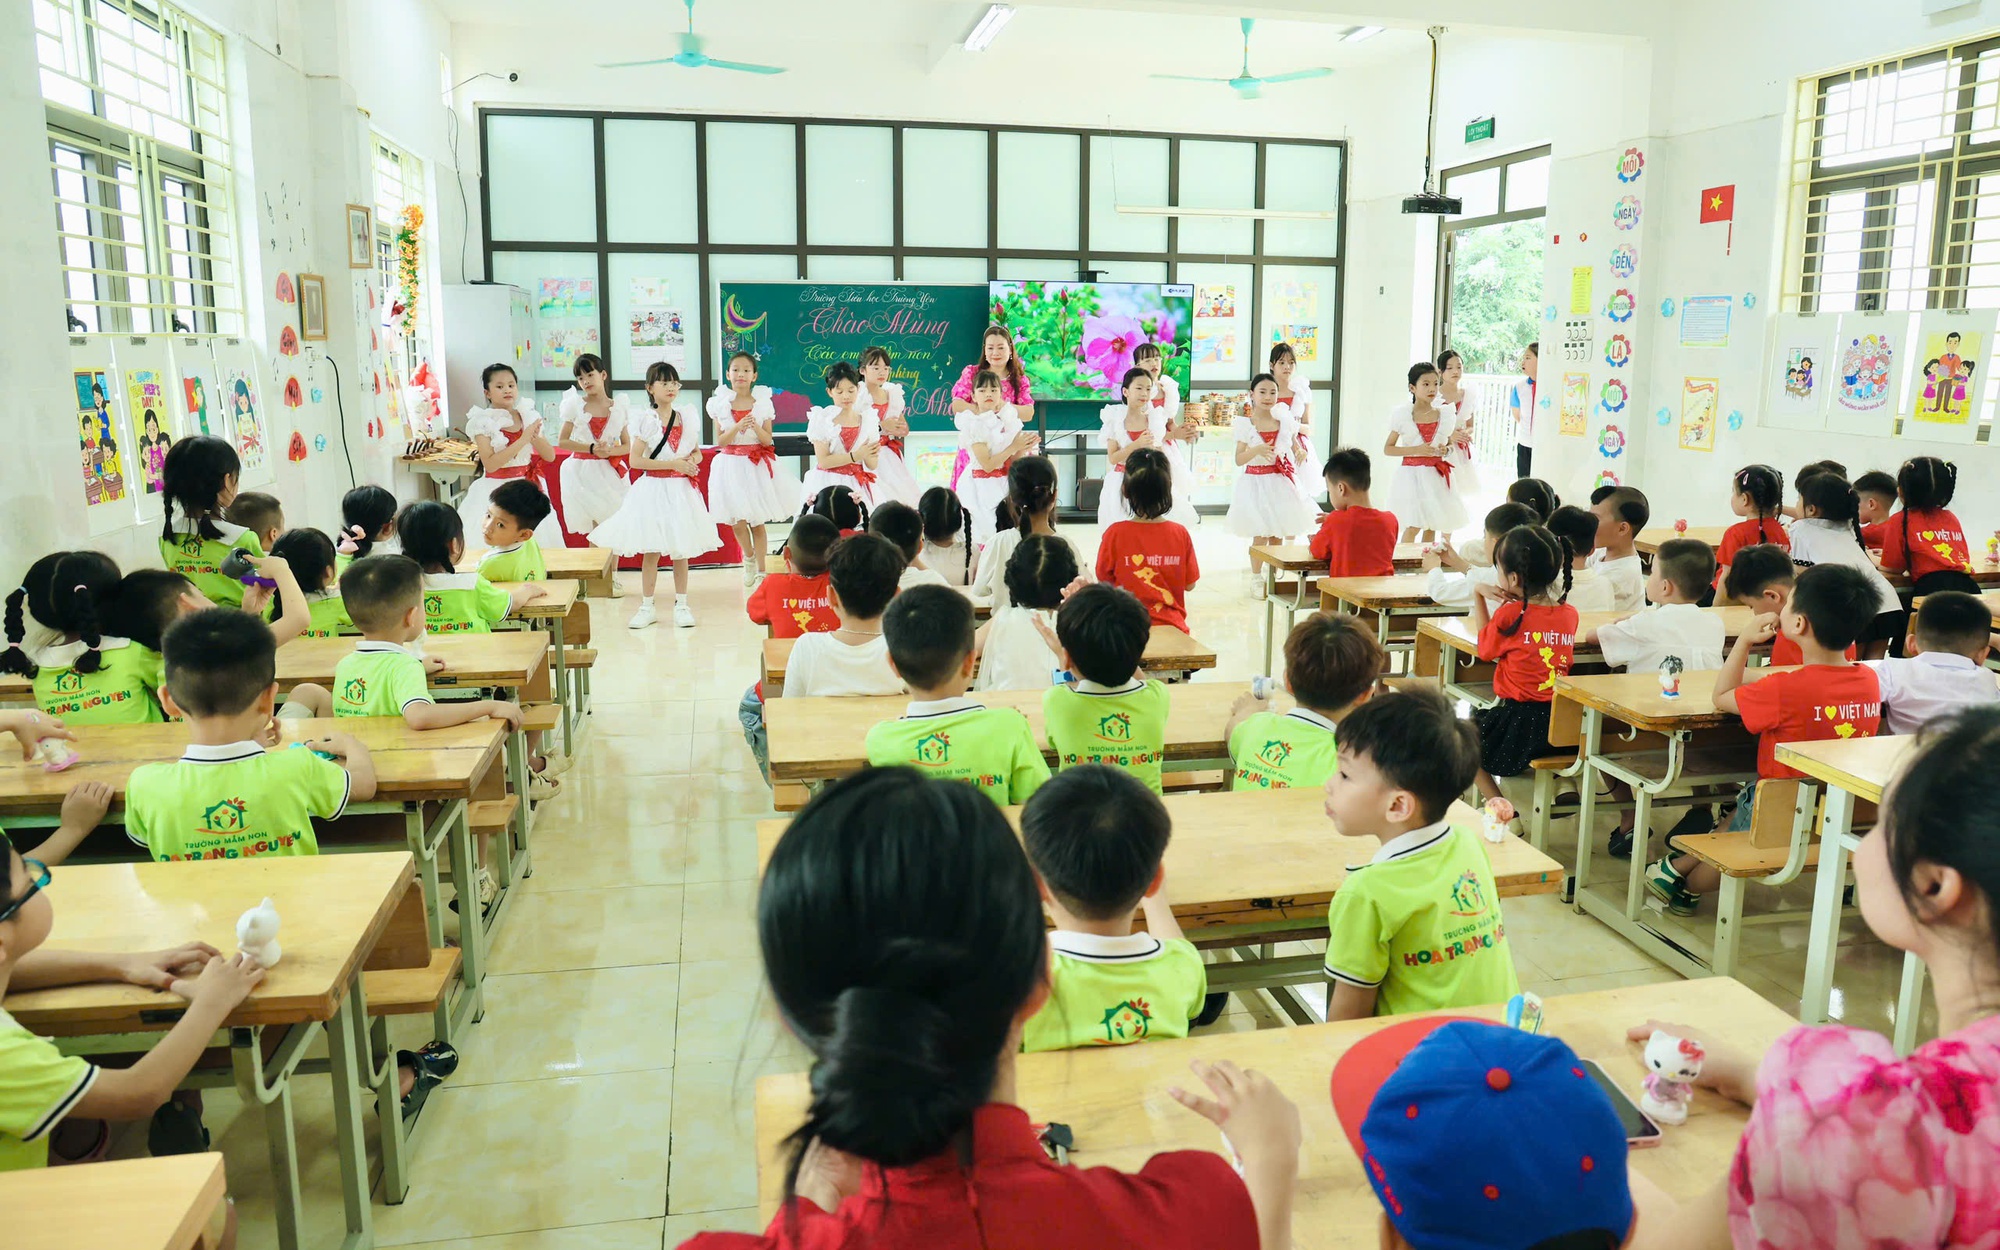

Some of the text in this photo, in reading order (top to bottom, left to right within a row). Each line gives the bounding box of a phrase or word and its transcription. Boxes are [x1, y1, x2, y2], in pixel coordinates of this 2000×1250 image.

[1618, 205, 1637, 220] NGÀY
[1615, 251, 1632, 269] ĐẾN
[866, 290, 879, 304] học
[797, 307, 869, 344] Chào
[1611, 342, 1622, 360] LÀ
[1603, 434, 1620, 448] NGÀY
[1124, 554, 1180, 567] I VIỆT NAM
[782, 597, 829, 611] I VIỆT NA
[1523, 632, 1530, 644] I
[1543, 629, 1560, 647] VIỆT
[1814, 705, 1822, 721] I
[1839, 700, 1861, 722] VIỆT
[1063, 753, 1084, 765] HOA
[955, 767, 971, 775] NON
[224, 835, 246, 844] MẦM
[248, 831, 268, 841] NON
[1403, 950, 1444, 967] HOA
